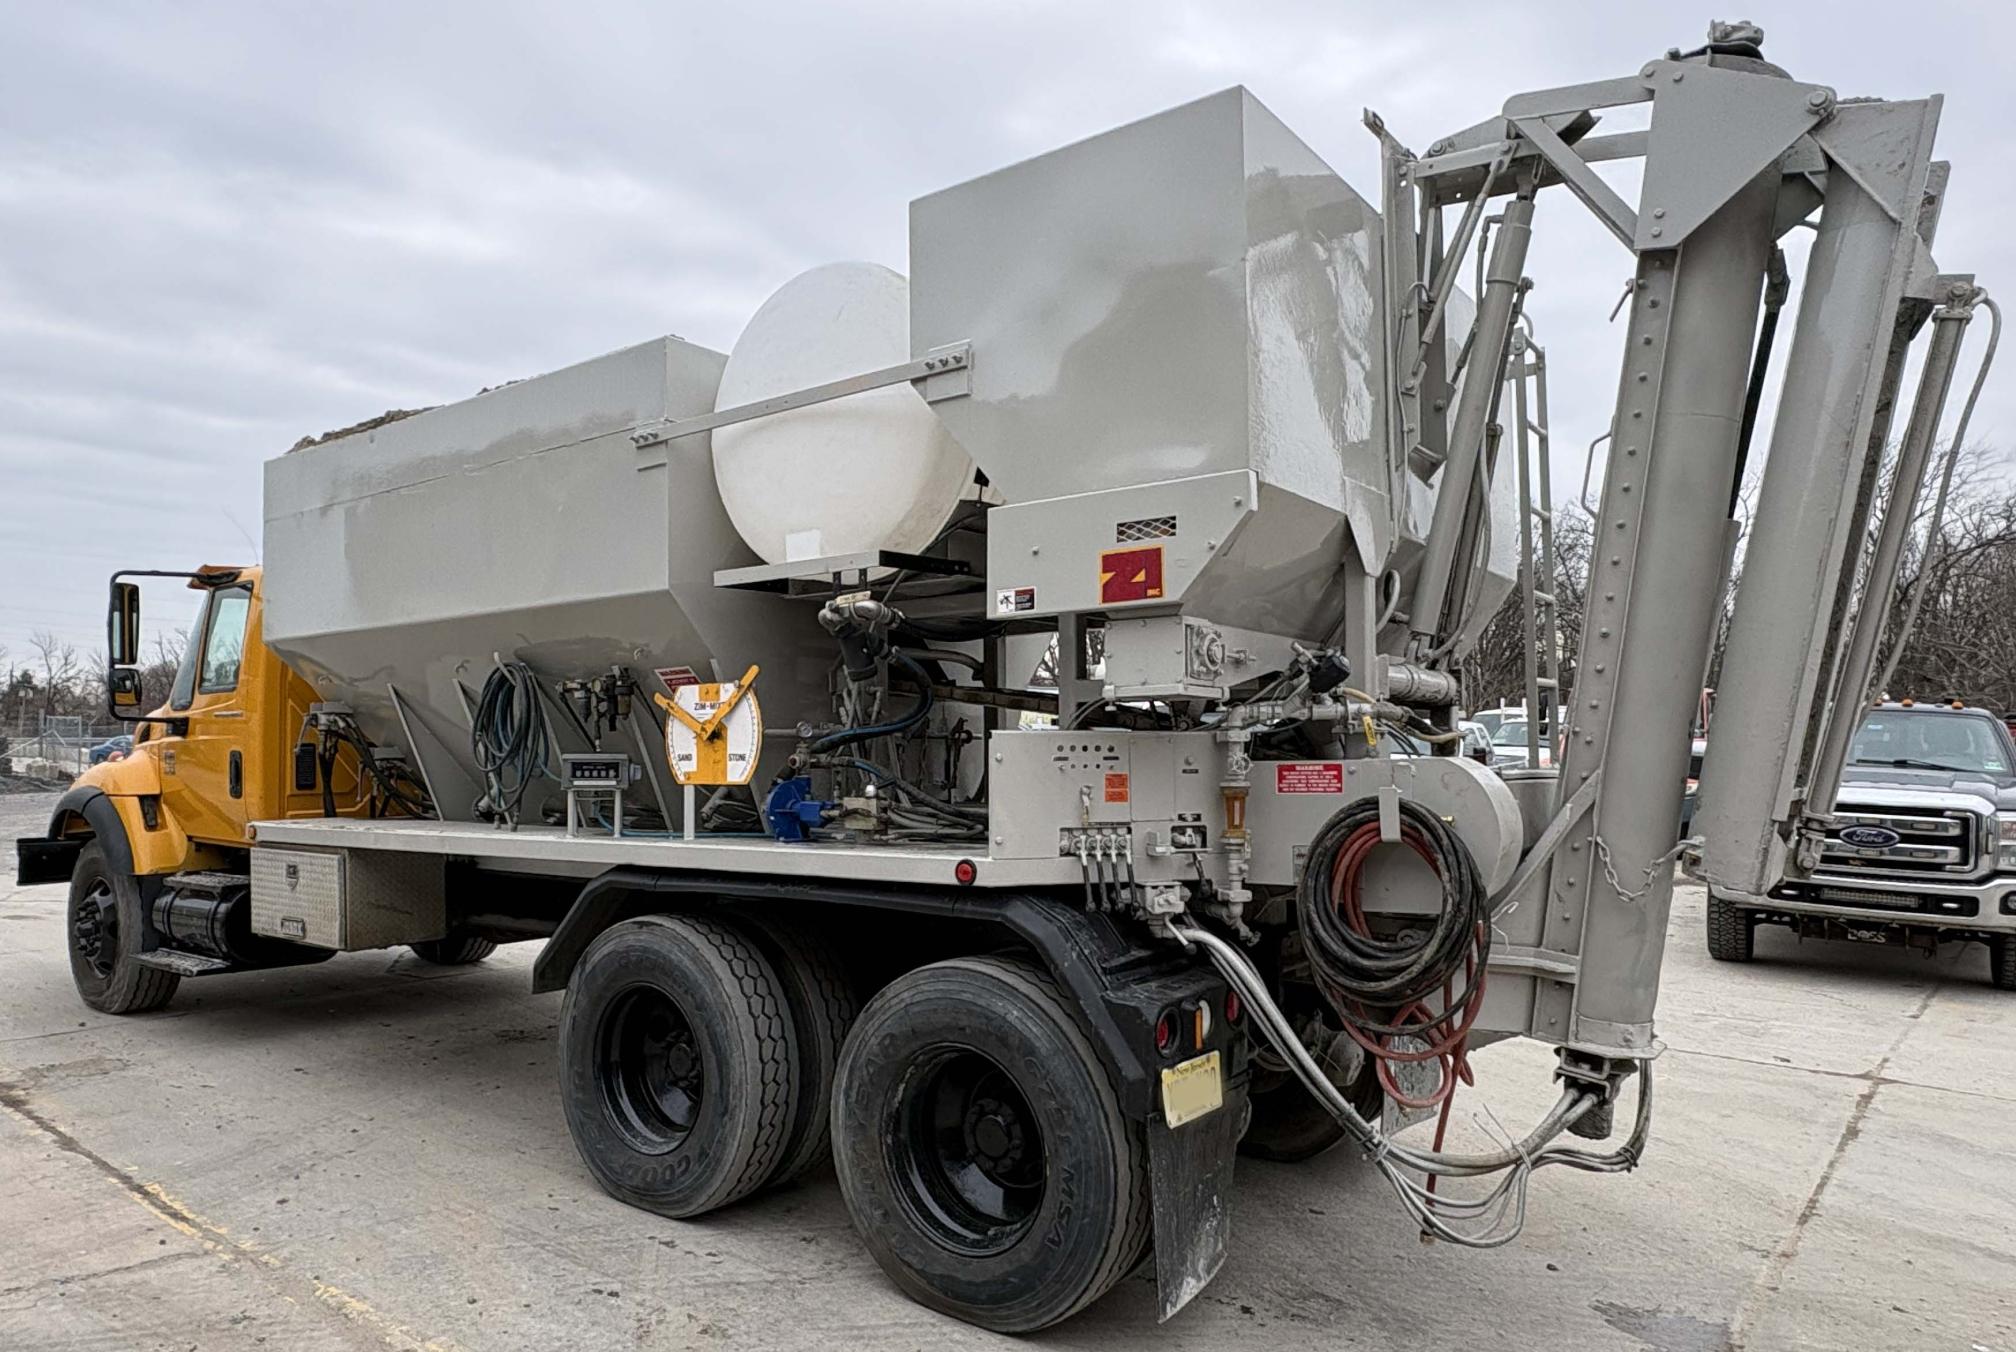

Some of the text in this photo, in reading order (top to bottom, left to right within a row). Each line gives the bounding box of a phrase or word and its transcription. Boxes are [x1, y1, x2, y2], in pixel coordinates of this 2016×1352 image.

[677, 753, 693, 762] SAND
[728, 753, 747, 762] STONE
[1852, 829, 1885, 843] Ford
[1044, 1166, 1076, 1250] MSA
